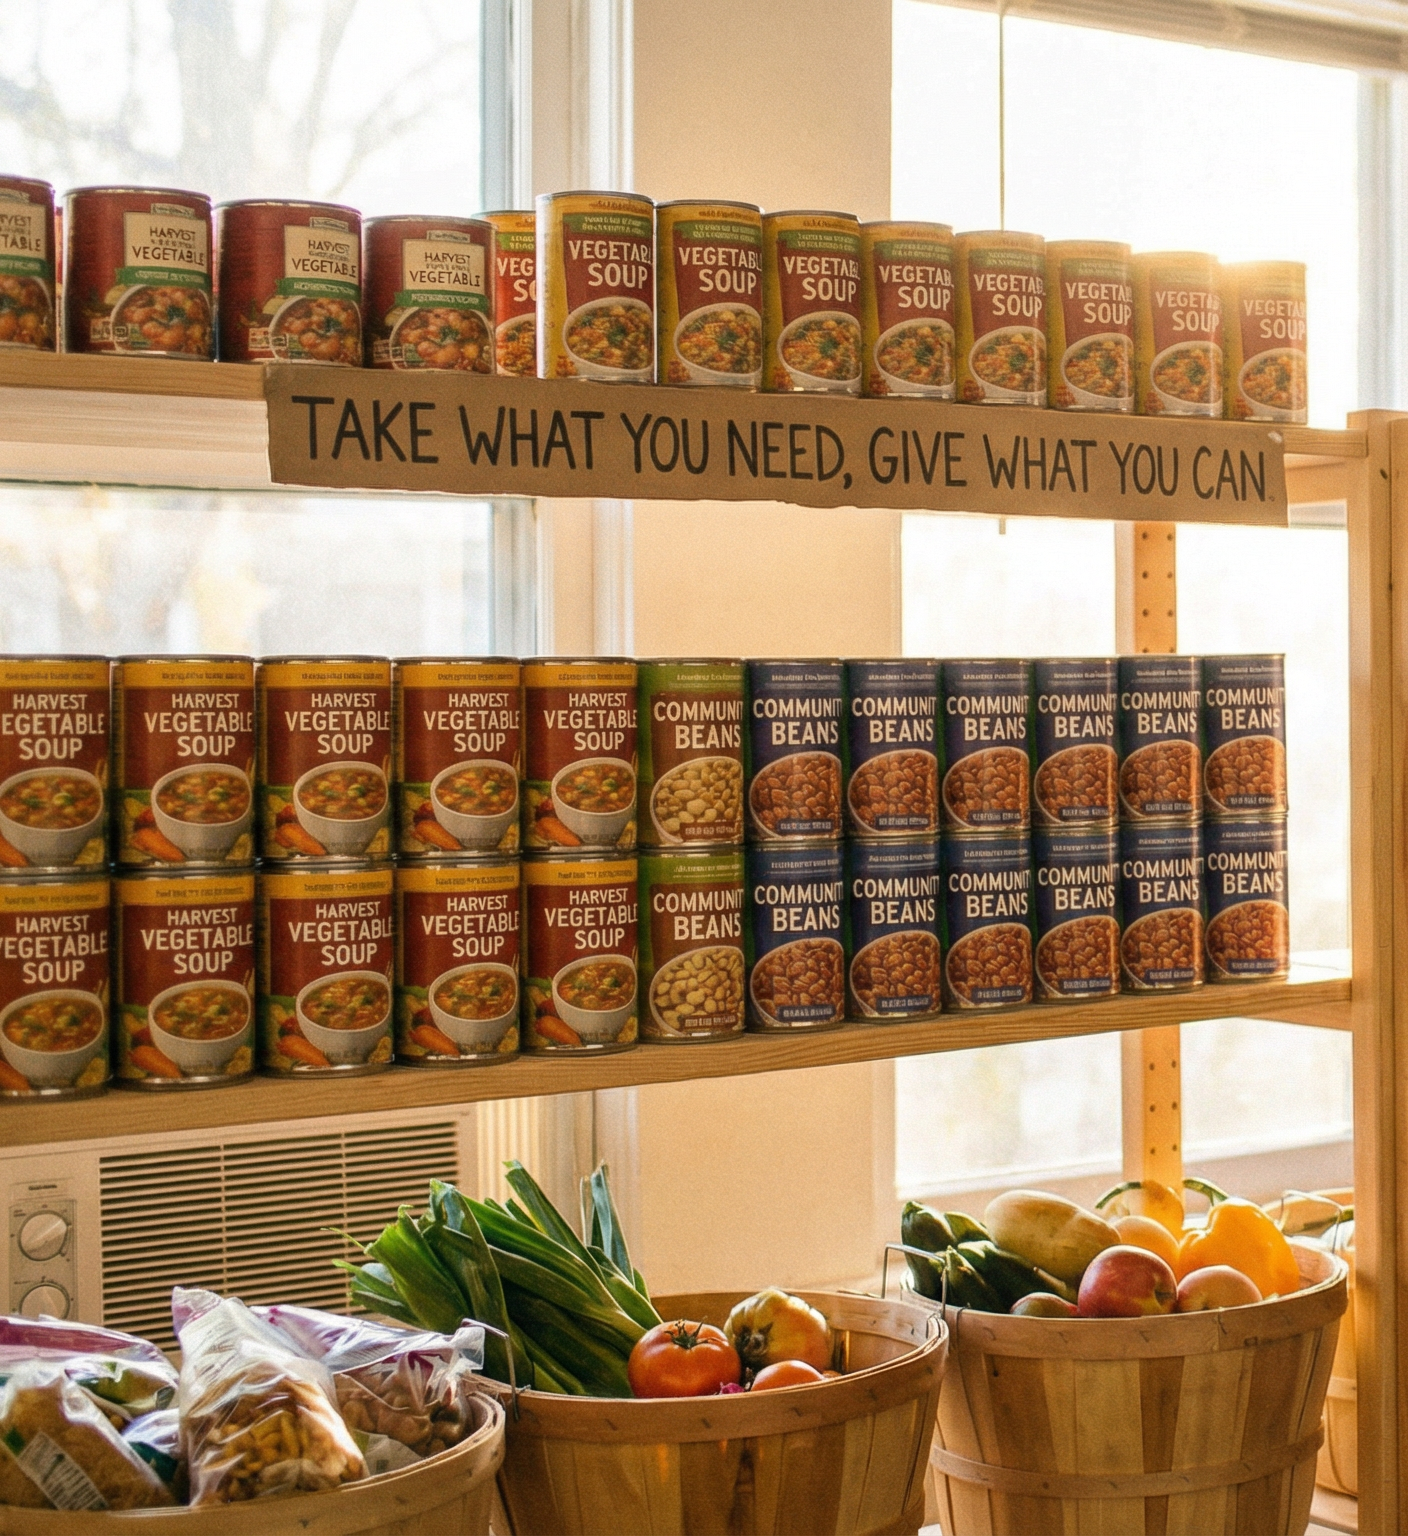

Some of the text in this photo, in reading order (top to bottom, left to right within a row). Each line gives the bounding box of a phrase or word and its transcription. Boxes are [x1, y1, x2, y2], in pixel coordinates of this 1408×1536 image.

[588, 262, 648, 289] SOUP
[699, 269, 756, 294] SOUP
[802, 278, 857, 303] SOUP
[898, 286, 951, 311] SOUP
[992, 294, 1042, 318] SOUP
[1083, 303, 1132, 325] SOUP
[1172, 311, 1219, 332] SOUP
[291, 395, 439, 464] TAKE
[458, 405, 605, 470] WHAT
[620, 412, 710, 474] YOU
[727, 418, 853, 490] NEED,
[868, 426, 968, 487] GIVE
[983, 433, 1098, 493] WHAT
[1108, 440, 1179, 497] YOU
[12, 693, 88, 711] HARVEST
[171, 693, 240, 709] HARVEST
[311, 692, 377, 708] HARVEST
[448, 693, 509, 709] HARVEST
[568, 693, 628, 708] HARVEST
[1, 712, 105, 737] EGETABLE
[144, 711, 253, 733] VEGETABLE
[285, 710, 390, 731] VEGETABLE
[869, 718, 934, 743] BEANS
[964, 716, 1026, 741] BEANS
[1054, 714, 1114, 738] BEANS
[1137, 711, 1197, 735] BEANS
[1221, 708, 1281, 730] BEANS
[317, 733, 373, 755] SOUP
[453, 733, 507, 753] SOUP
[573, 731, 625, 751] SOUP
[675, 724, 741, 750] BEANS
[771, 721, 839, 746] BEANS
[18, 737, 83, 761] SOUP
[177, 735, 236, 757] SOUP
[1139, 879, 1199, 903] BEANS
[1223, 872, 1284, 895] BEANS
[446, 895, 508, 912] HARVEST
[569, 888, 628, 906] HARVEST
[966, 893, 1028, 918] BEANS
[1054, 885, 1115, 911] BEANS
[167, 908, 238, 926] HARVEST
[315, 901, 380, 920] HARVEST
[773, 905, 840, 932] BEANS
[870, 899, 935, 925] BEANS
[15, 914, 90, 934] HARVEST
[288, 916, 393, 943] VEGETABLE
[673, 914, 741, 941] BEANS
[141, 924, 254, 951] VEGETABLE
[452, 935, 505, 958] SOUP
[574, 928, 626, 950] SOUP
[173, 949, 234, 974] SOUP
[321, 943, 378, 967] SOUP
[22, 959, 86, 984] SOUP
